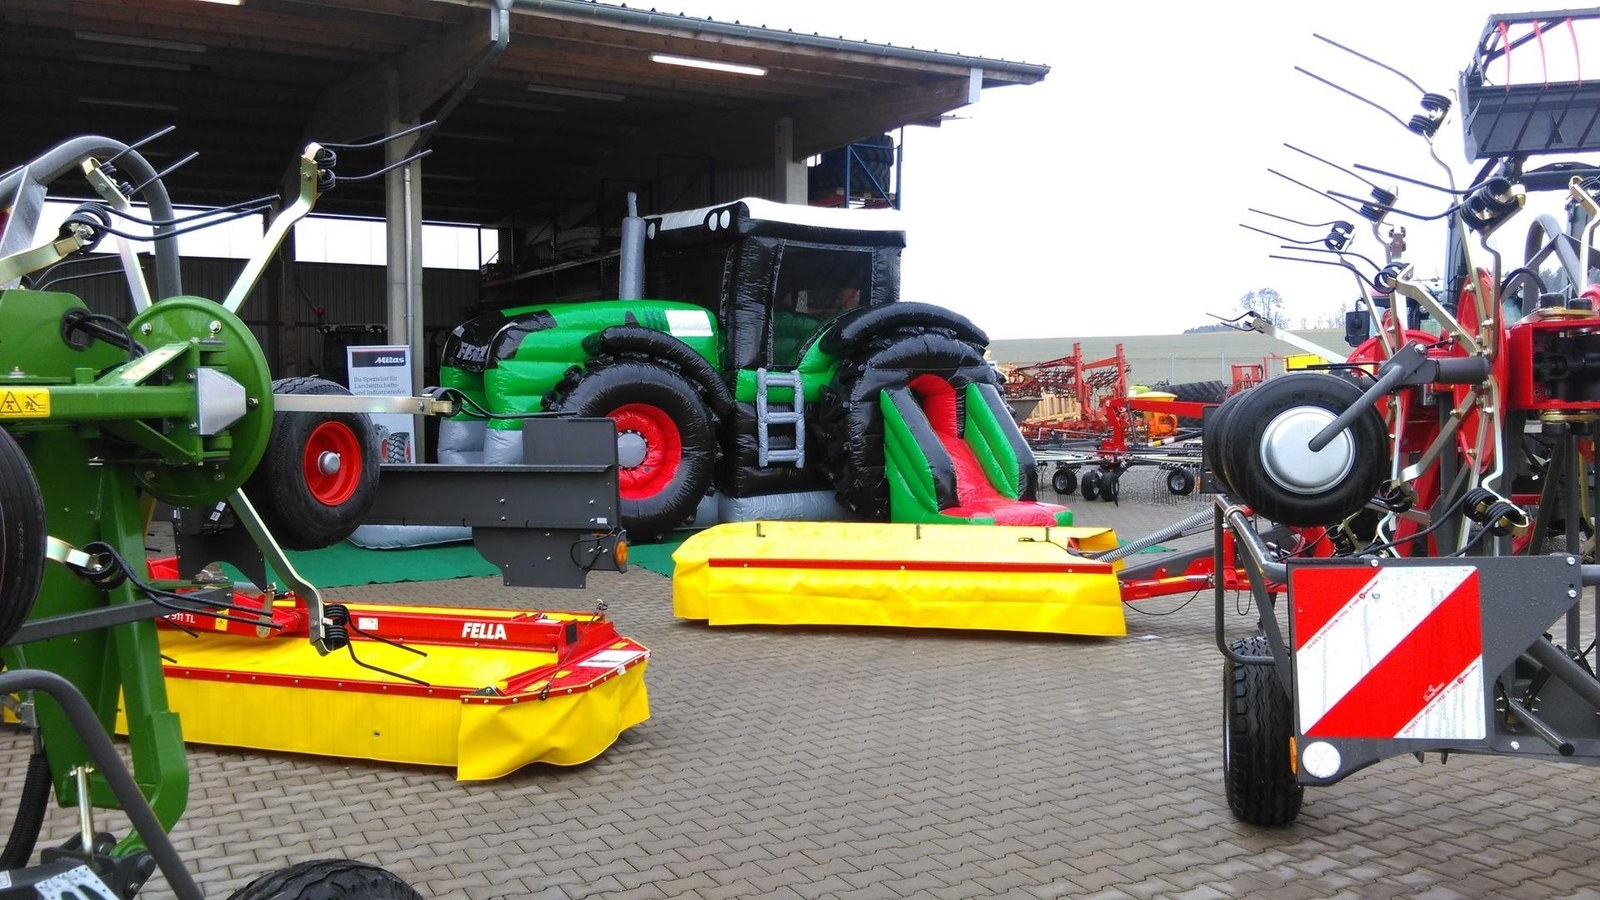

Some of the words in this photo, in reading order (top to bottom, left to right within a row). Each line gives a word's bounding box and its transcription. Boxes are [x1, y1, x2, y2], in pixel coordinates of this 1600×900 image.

[374, 356, 405, 364] Mitas
[185, 613, 196, 624] TL
[461, 621, 508, 640] FELLA
